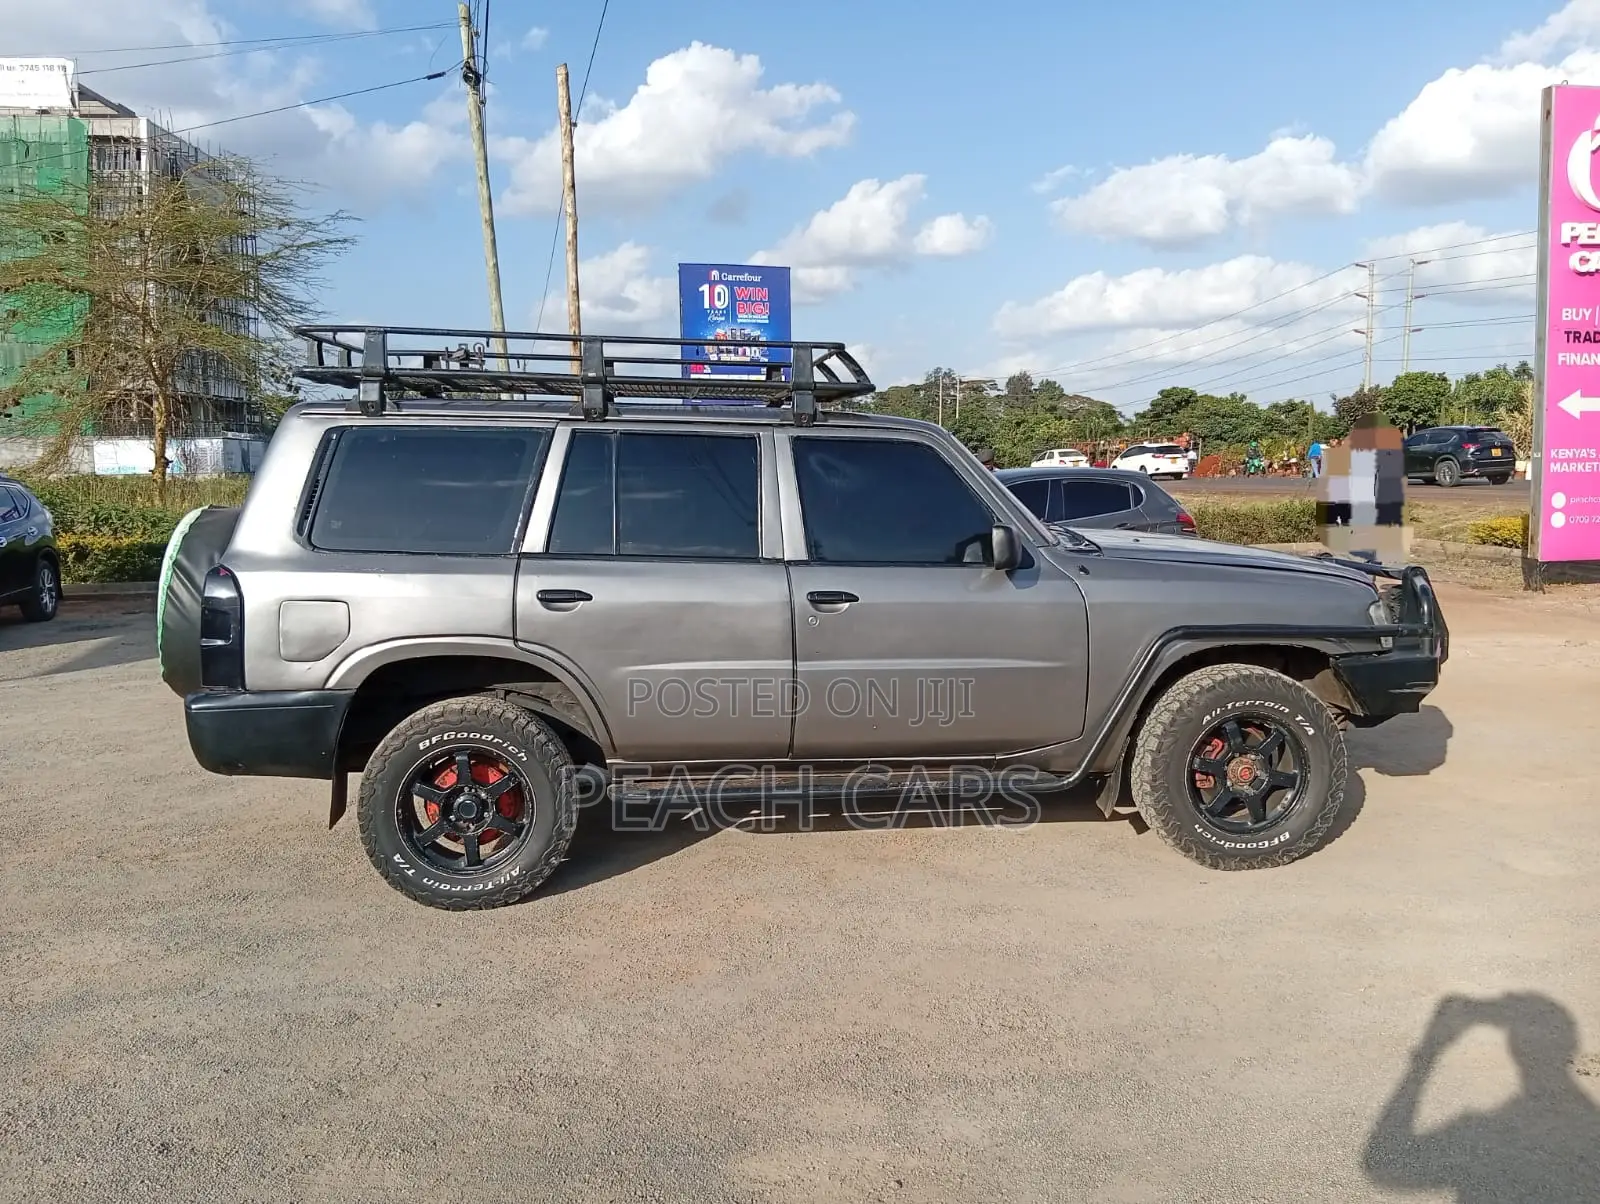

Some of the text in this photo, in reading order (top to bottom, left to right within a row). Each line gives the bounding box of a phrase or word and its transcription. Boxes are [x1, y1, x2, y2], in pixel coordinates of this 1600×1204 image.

[1560, 222, 1600, 246] PE
[721, 272, 762, 282] Carrefour
[698, 283, 729, 309] 10
[733, 286, 769, 301] WIN
[736, 301, 770, 316] BIG!
[1562, 307, 1593, 321] BUY
[1550, 448, 1597, 459] KENYA'S
[1550, 462, 1600, 473] MARKET
[1202, 700, 1316, 737] All-Terrain T/A
[418, 731, 528, 762] BFGoodrich
[1194, 823, 1291, 849] BFGoodrich
[392, 853, 521, 892] All-Terrain T/A
